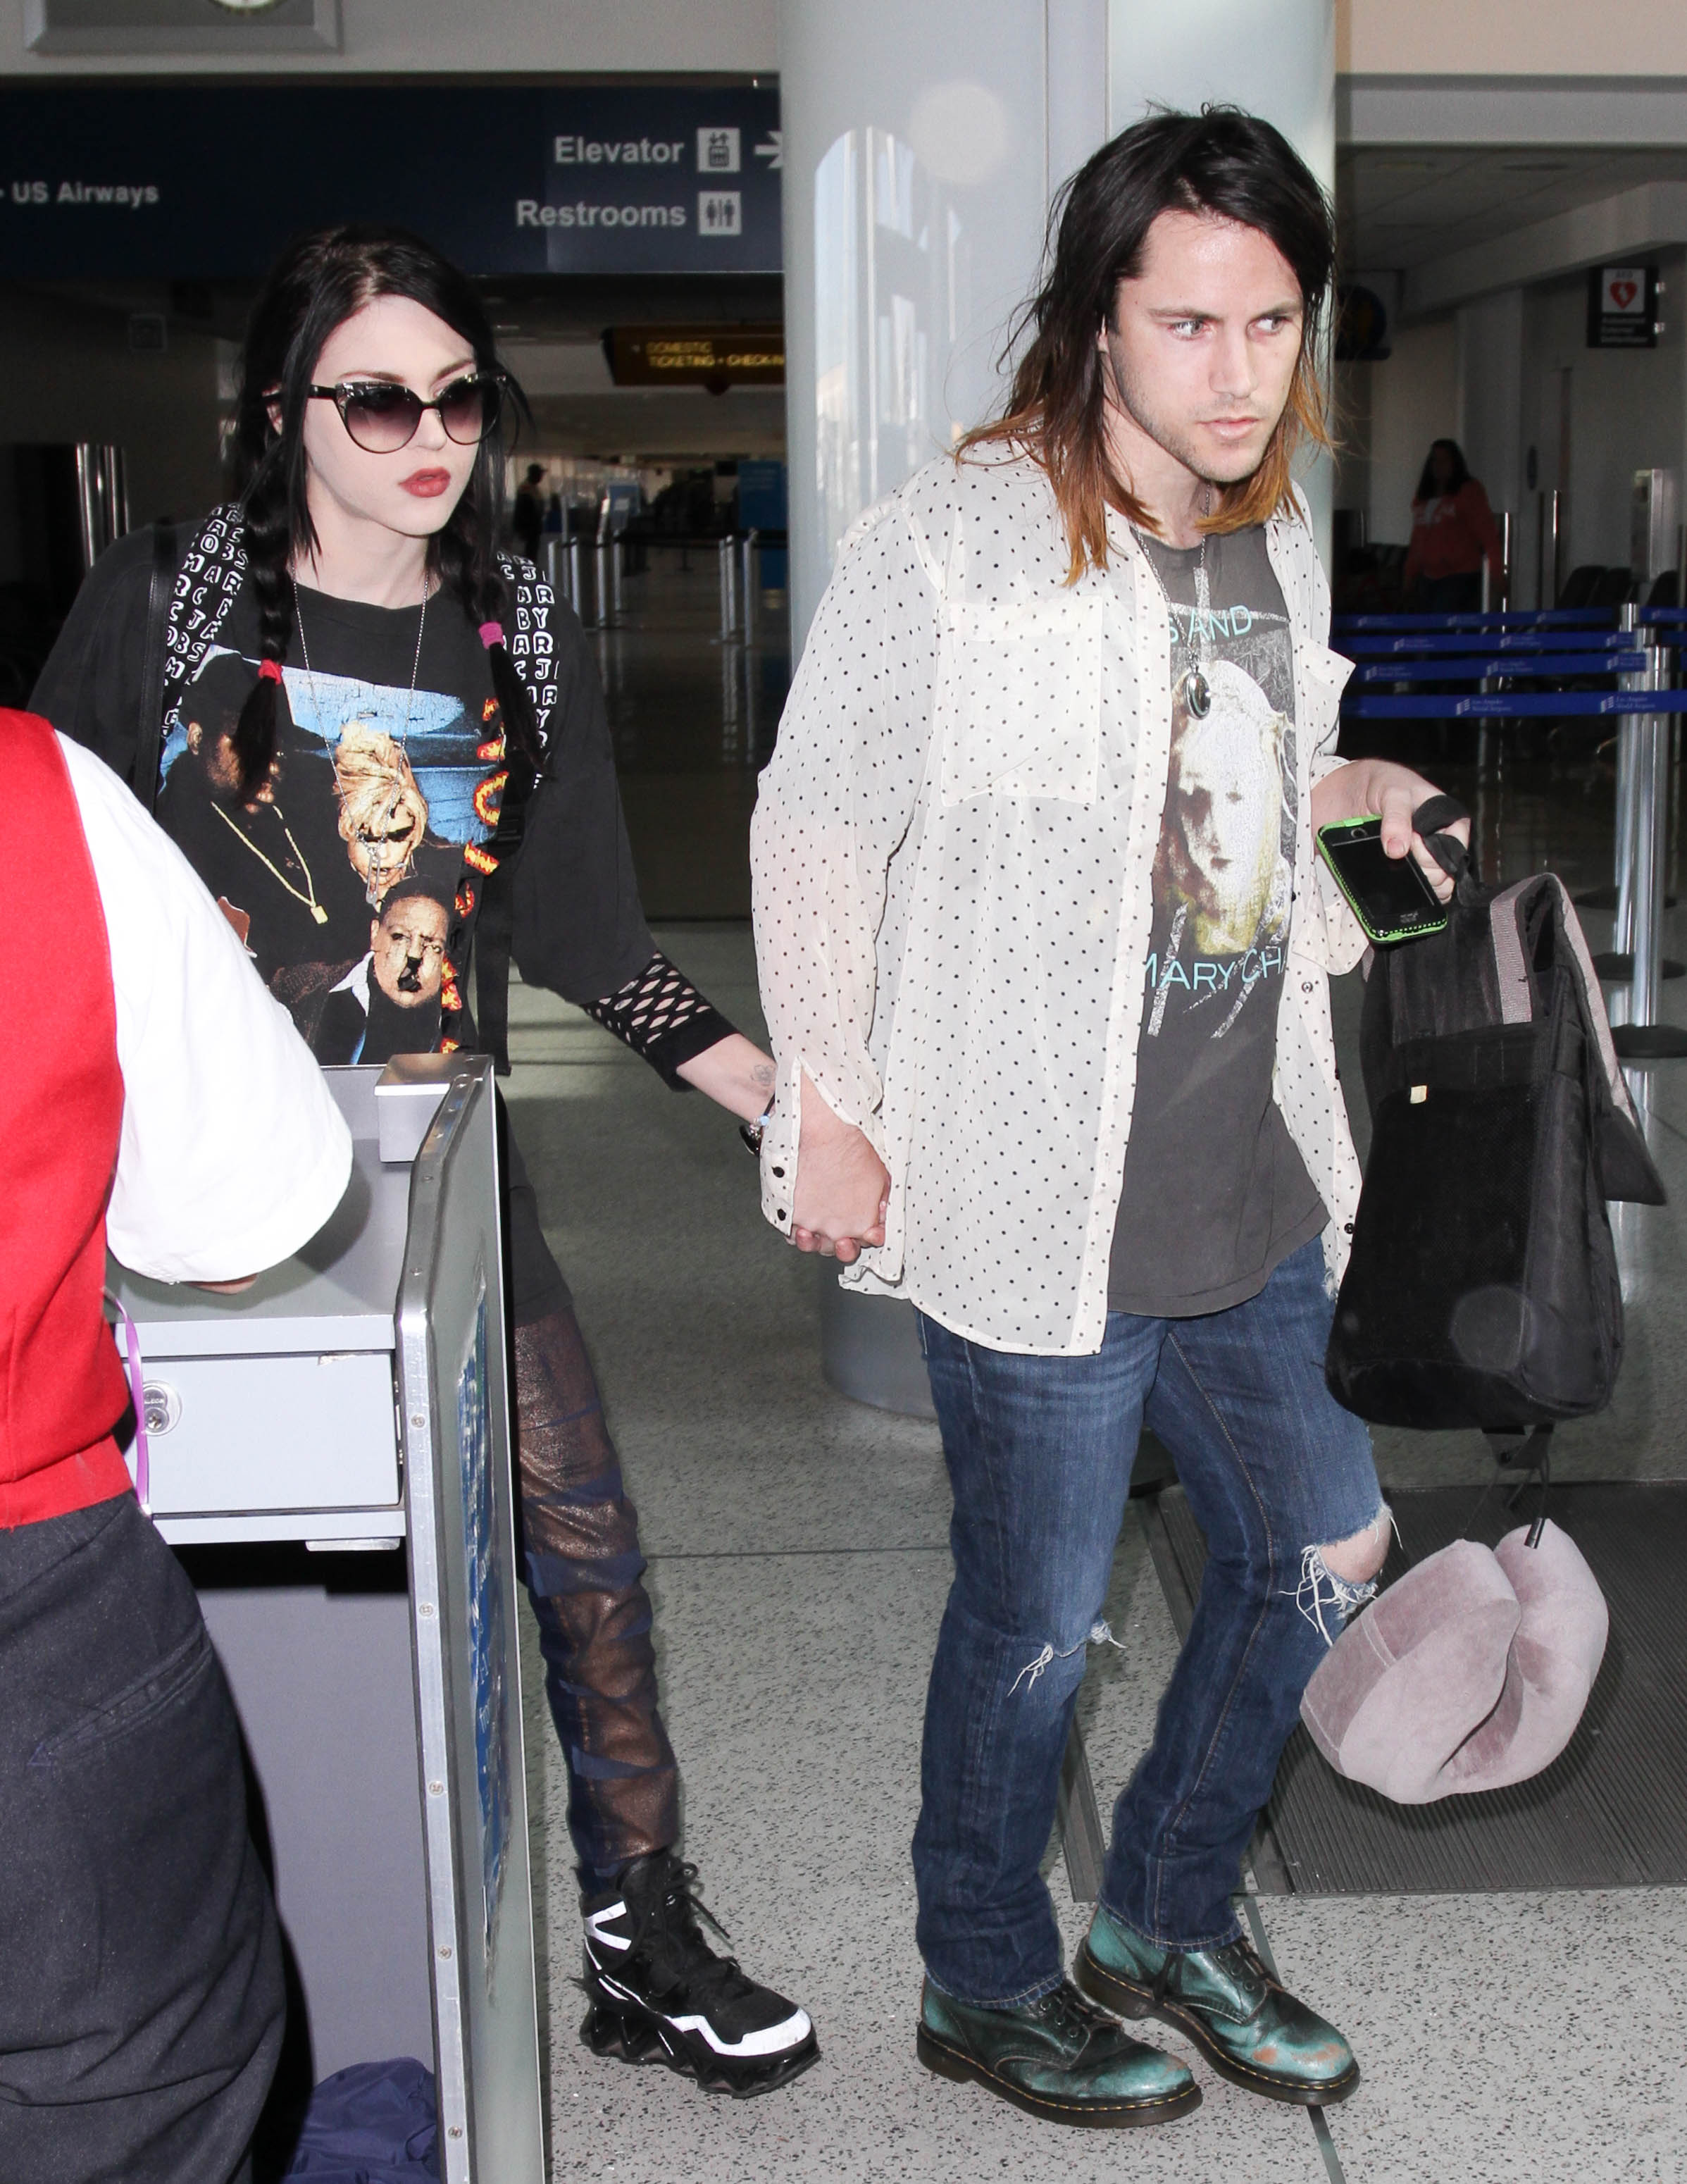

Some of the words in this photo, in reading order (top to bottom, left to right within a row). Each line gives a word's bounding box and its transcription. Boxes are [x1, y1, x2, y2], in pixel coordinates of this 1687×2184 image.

[554, 136, 685, 163] Elevator
[12, 180, 49, 203] US
[57, 180, 159, 209] Airways
[516, 199, 687, 226] Restrooms
[1188, 605, 1252, 641] AND
[1242, 948, 1286, 983] CH
